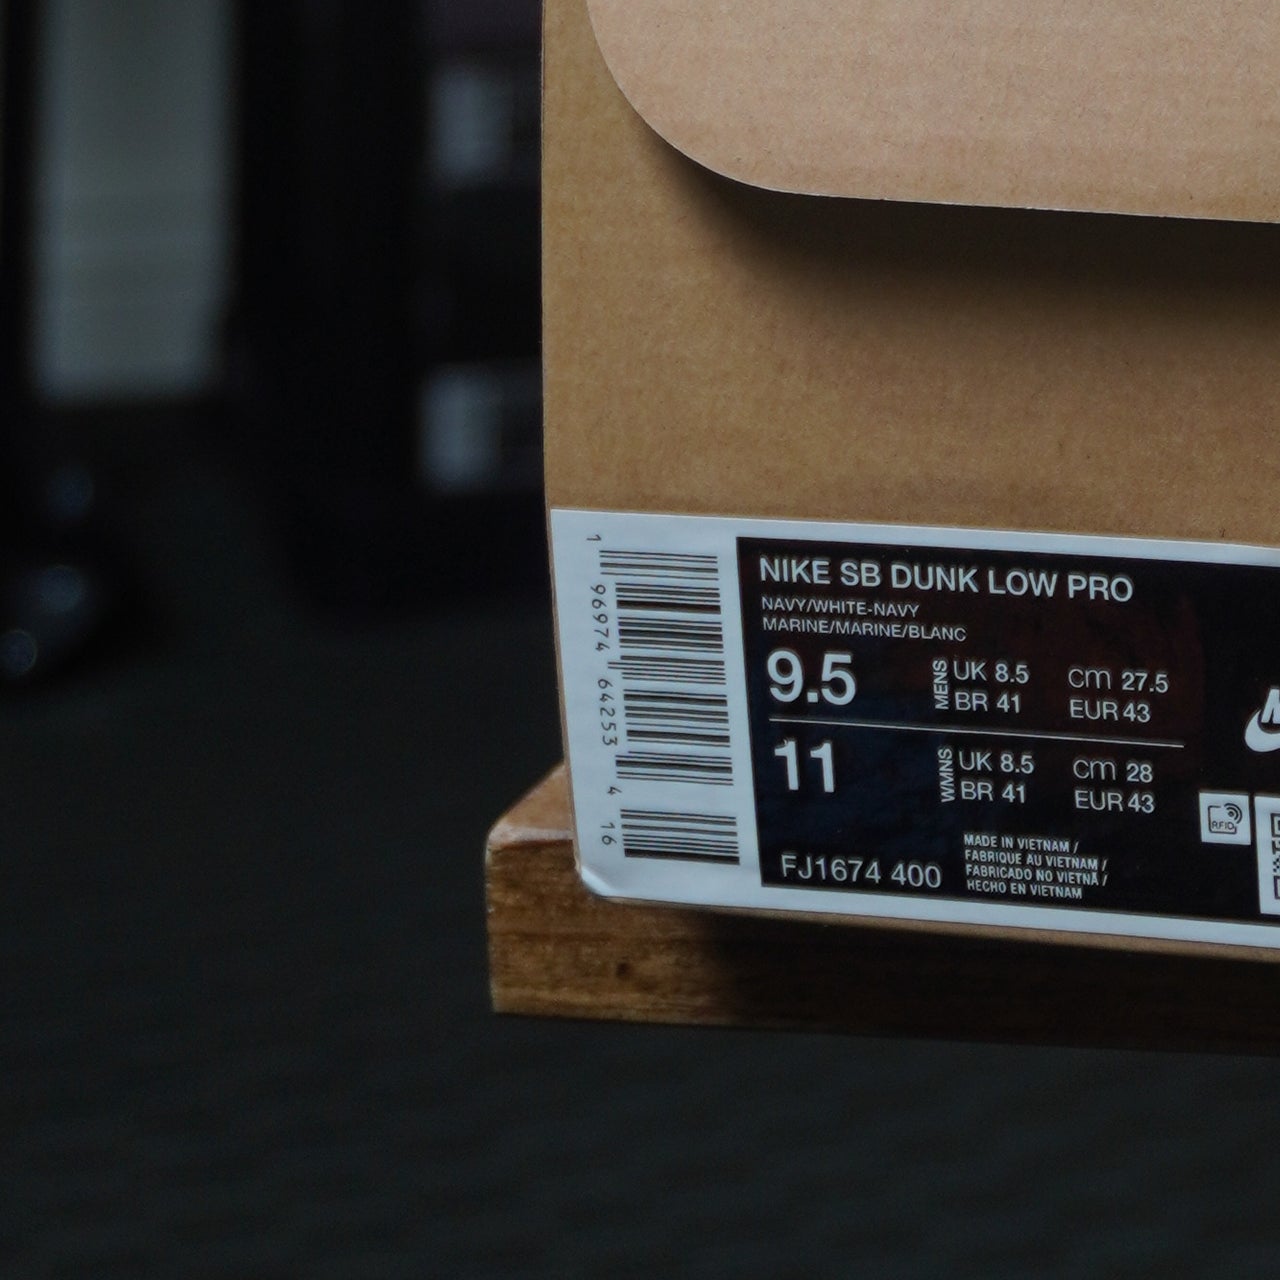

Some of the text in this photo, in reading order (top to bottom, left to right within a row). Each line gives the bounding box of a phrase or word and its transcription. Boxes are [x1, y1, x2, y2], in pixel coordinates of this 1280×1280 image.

[586, 534, 602, 542] 1
[760, 557, 1133, 602] NIKE SB DUNK LOW PRO
[590, 584, 610, 652] 96974
[762, 596, 919, 618] NAVY/WHITE-NAVY
[763, 617, 967, 642] MARINE/MARINE/BLANC
[767, 650, 856, 706] 9.5
[953, 660, 1030, 684] UK 8.5
[1068, 668, 1169, 693] cm 27.5
[932, 659, 949, 710] MENS
[597, 678, 618, 746] 64253
[955, 691, 1021, 714] BR 41
[1069, 699, 1151, 723] EUR 43
[774, 739, 834, 793] 11
[958, 751, 1035, 774] UK 8.5
[1073, 759, 1154, 783] cm 28
[937, 748, 956, 803] WMNS
[607, 786, 622, 796] 4
[960, 780, 1026, 804] BR 41
[1074, 790, 1156, 814] EUR 43
[601, 822, 618, 846] 16
[963, 834, 998, 847] MADE
[1001, 836, 1014, 849] IN
[1017, 838, 1070, 852] VIETNAM
[781, 854, 942, 888] FJ1674 400
[964, 849, 1022, 865] FABRIQUE
[1026, 854, 1042, 867] AU
[1045, 855, 1099, 871] VIETNAM
[965, 864, 1032, 880] FABRICADO
[1035, 869, 1053, 882] NO
[966, 879, 1083, 900] HECHO EN VIETNAM
